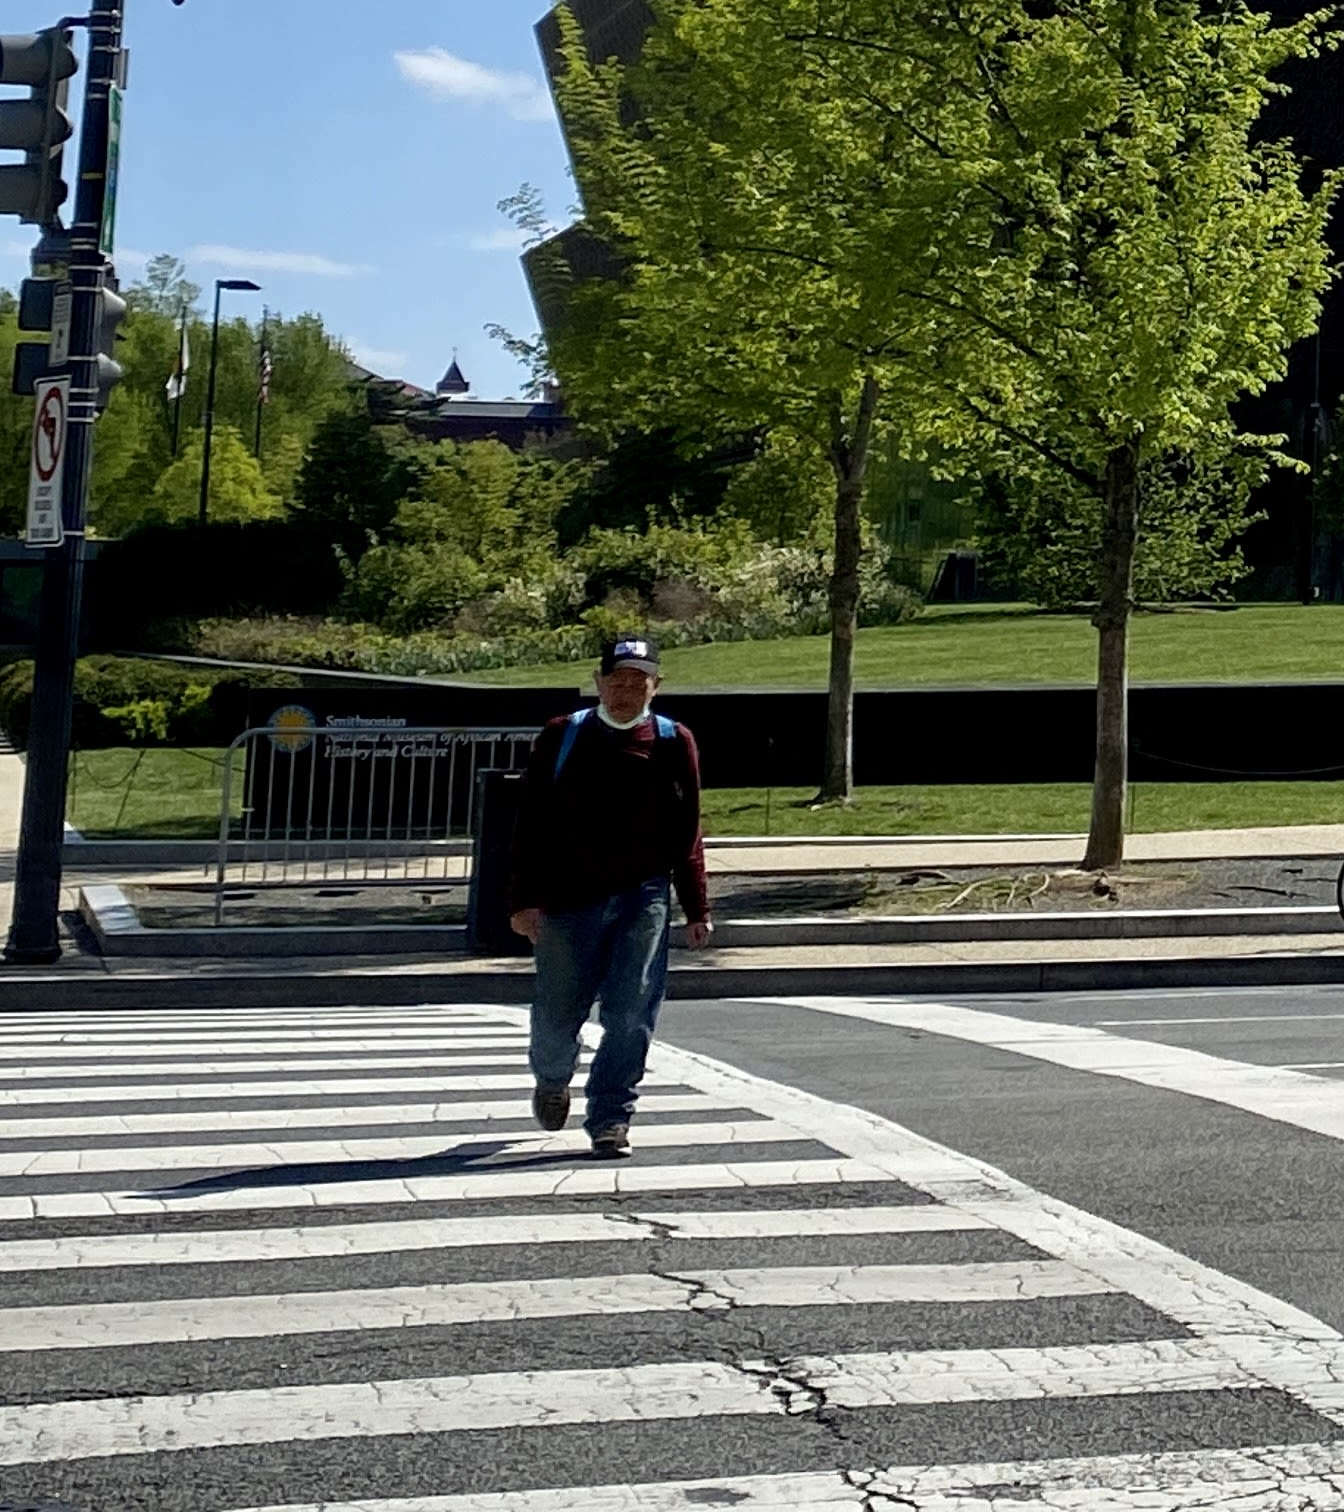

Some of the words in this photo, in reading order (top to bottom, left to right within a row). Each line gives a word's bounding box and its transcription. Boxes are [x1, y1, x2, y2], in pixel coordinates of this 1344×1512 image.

[326, 714, 406, 727] Smithsonian
[440, 732, 452, 745] of
[324, 745, 371, 760] History
[372, 744, 399, 758] and
[401, 744, 448, 758] Culture
